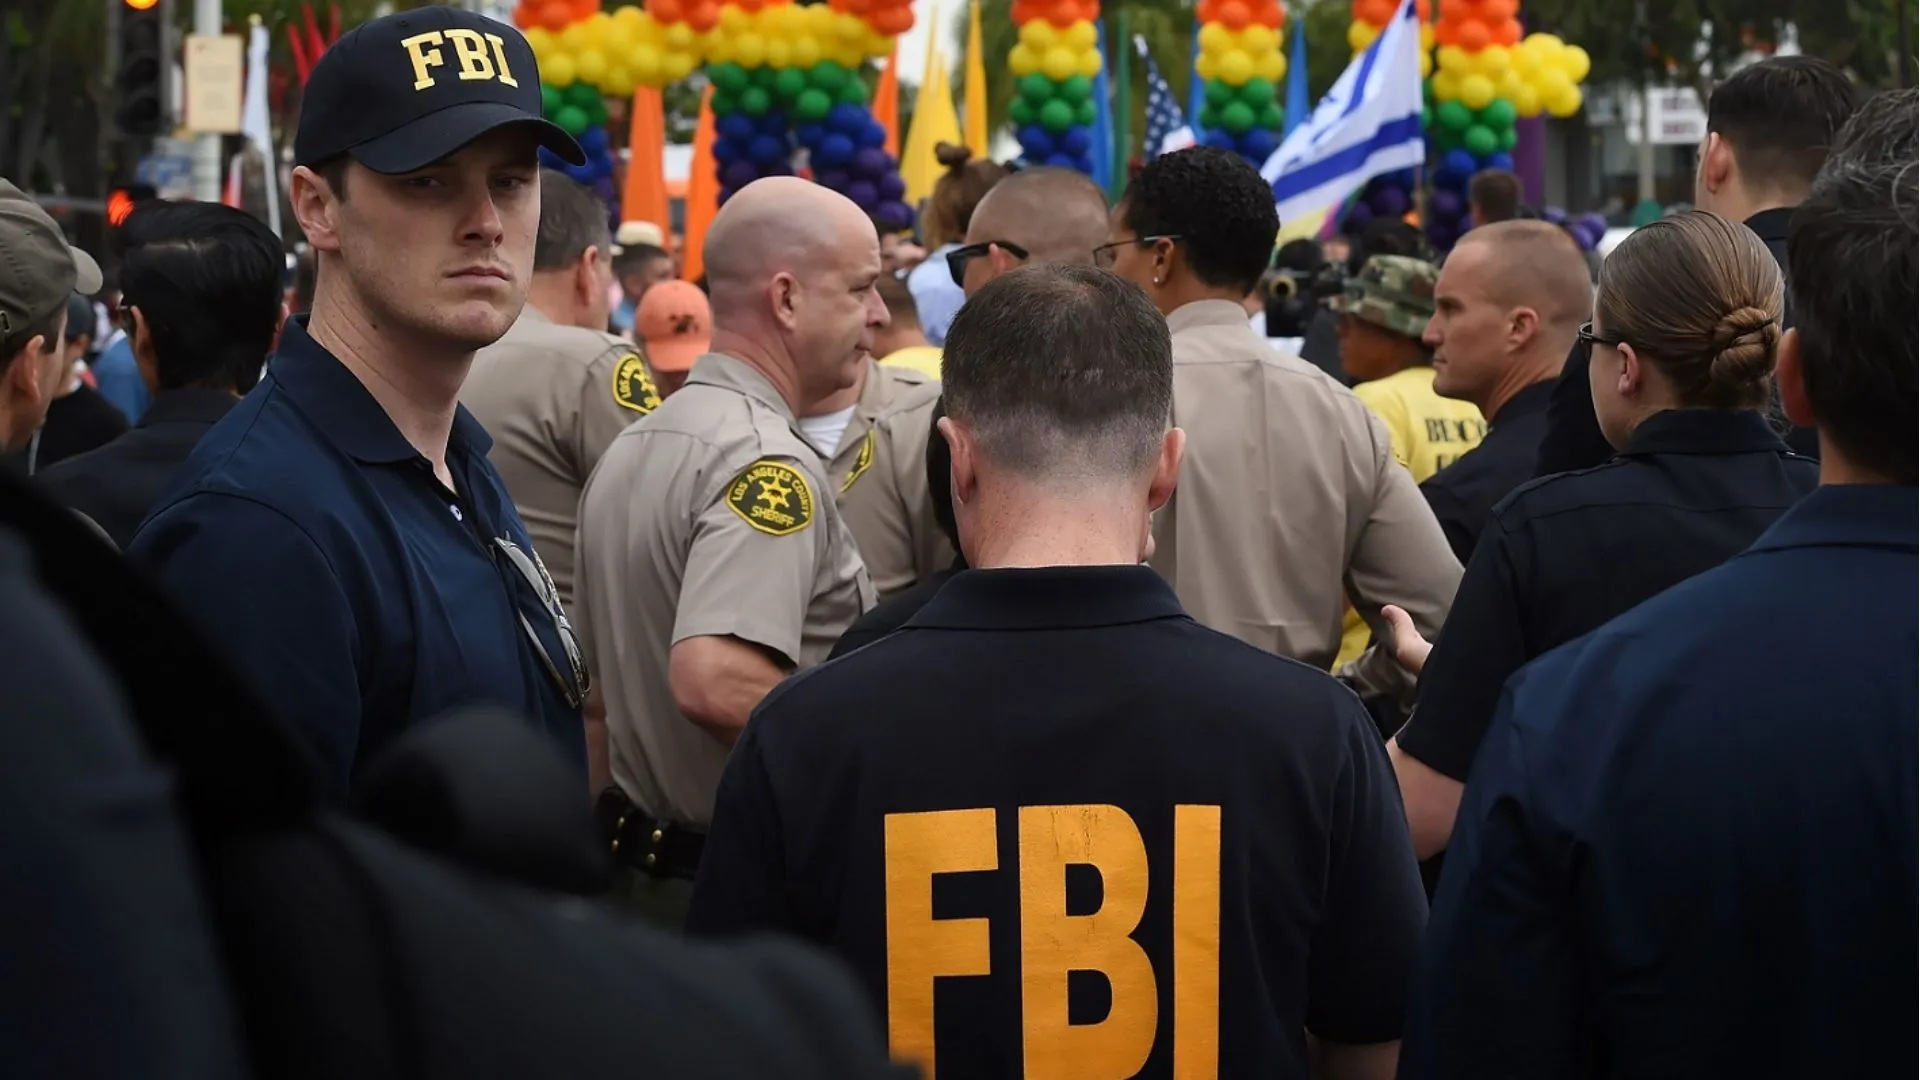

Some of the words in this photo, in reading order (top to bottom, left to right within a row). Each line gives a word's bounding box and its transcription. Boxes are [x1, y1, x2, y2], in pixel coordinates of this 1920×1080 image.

[401, 28, 518, 91] FBI
[731, 481, 749, 501] LOS
[746, 467, 793, 484] ANGELES
[791, 479, 811, 519] COUNTY
[750, 505, 796, 527] SHERIFF
[884, 803, 1222, 1080] FBI
